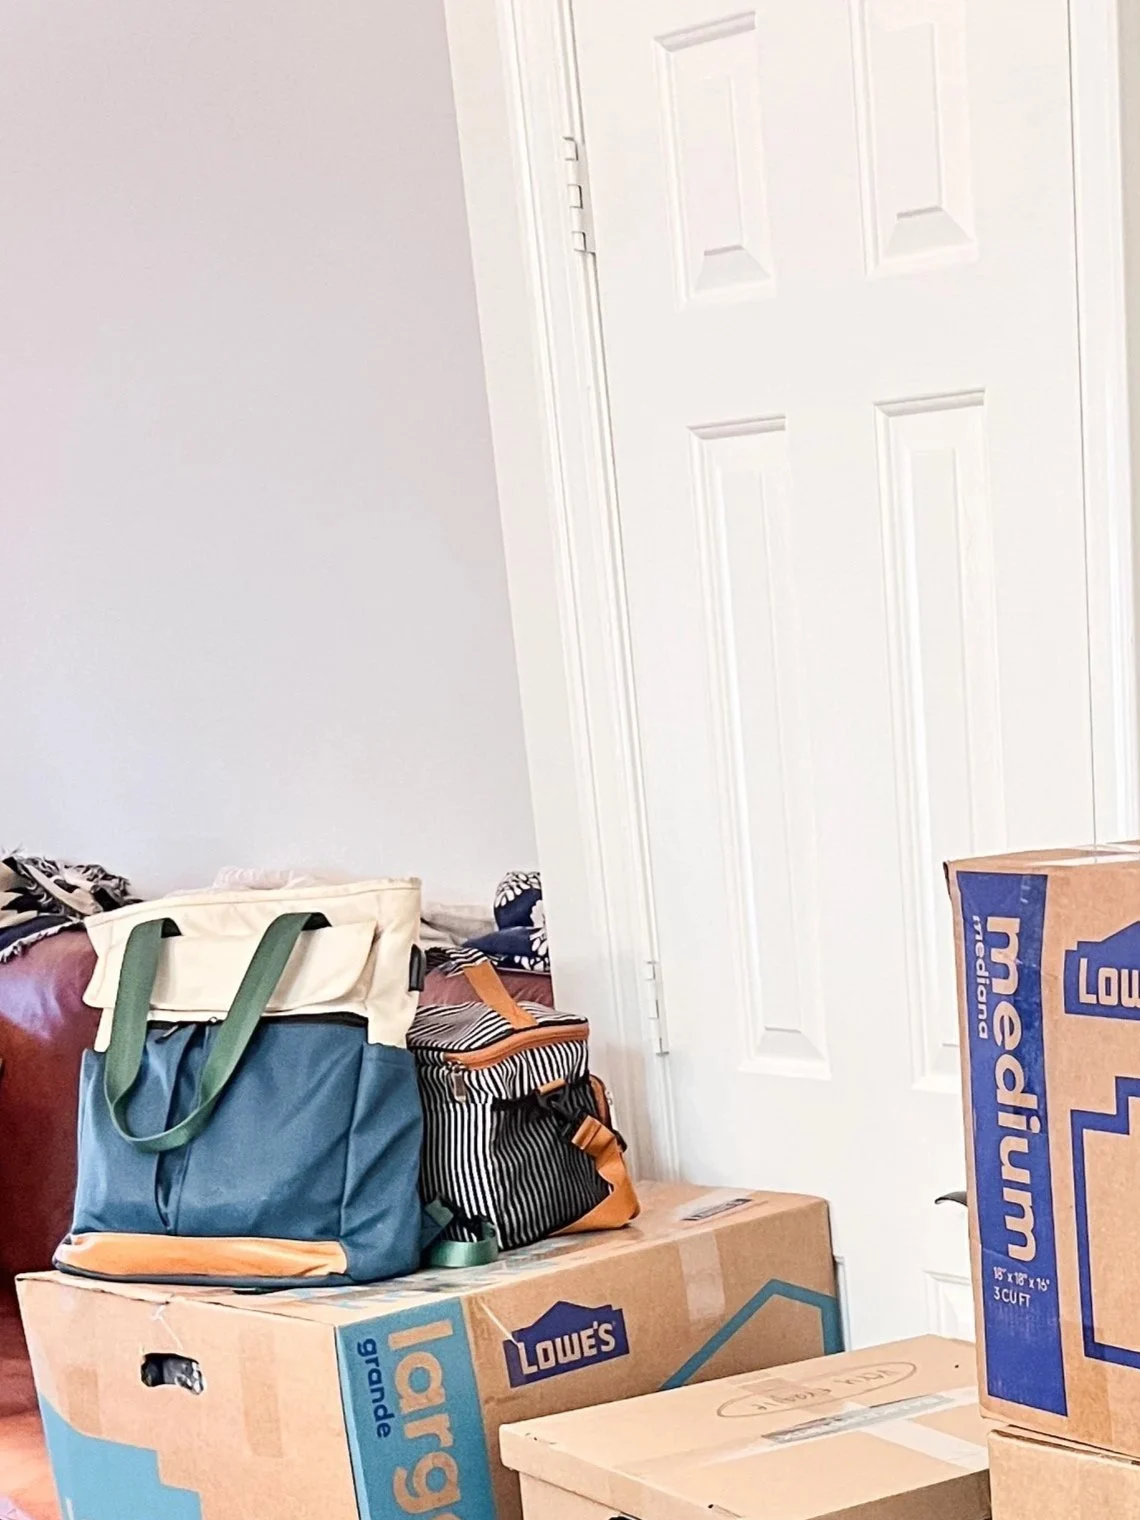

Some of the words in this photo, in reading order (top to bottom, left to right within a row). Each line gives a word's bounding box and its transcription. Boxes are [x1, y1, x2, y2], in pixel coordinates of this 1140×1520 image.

[972, 915, 988, 1040] mediana
[986, 915, 1041, 1262] medium
[994, 1286, 1000, 1300] 3
[1002, 1288, 1017, 1304] CU
[1019, 1292, 1030, 1308] FT
[358, 1338, 396, 1439] grande
[518, 1320, 616, 1376] LOWE'S
